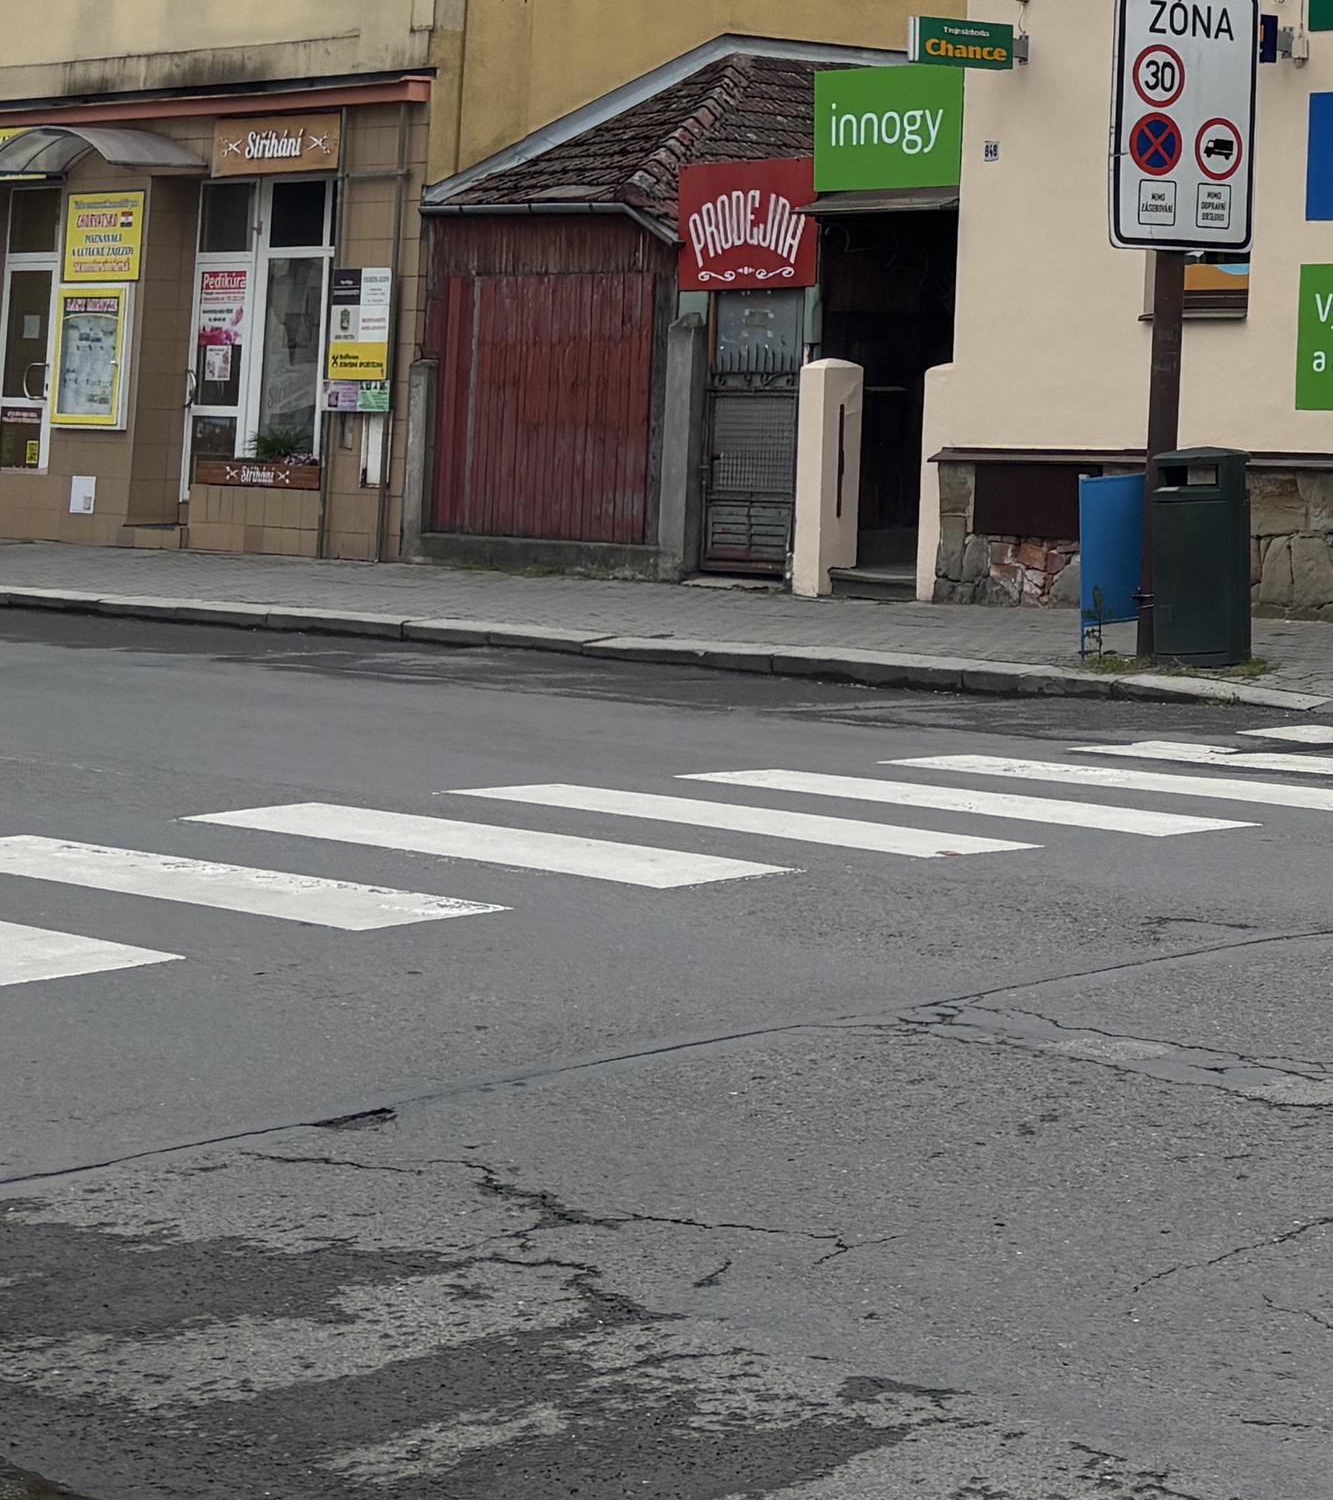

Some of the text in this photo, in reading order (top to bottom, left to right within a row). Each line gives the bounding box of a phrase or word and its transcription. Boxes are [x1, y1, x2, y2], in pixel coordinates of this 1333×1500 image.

[925, 38, 1008, 61] Chance
[1144, 59, 1176, 93] 30
[245, 128, 304, 160] Stříhání
[831, 102, 944, 155] innogy
[688, 189, 806, 269] PRODEJNA
[203, 272, 246, 290] Pedikúra
[1312, 350, 1327, 372] a
